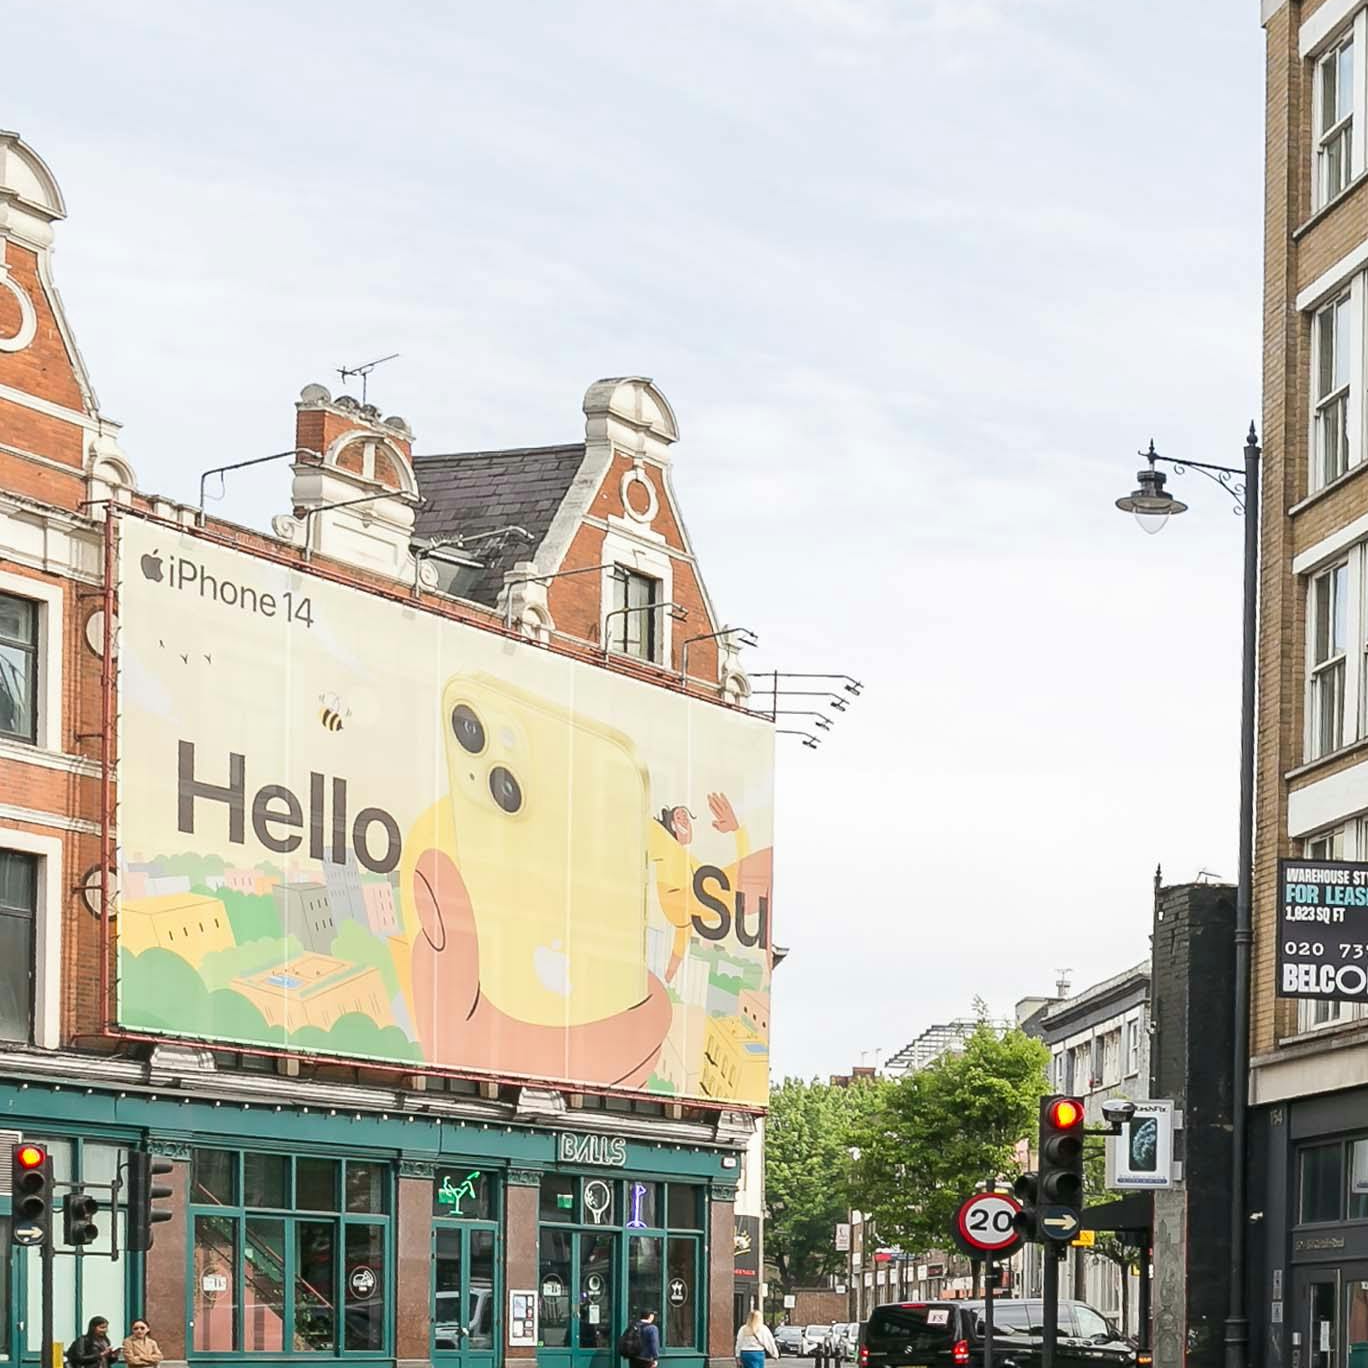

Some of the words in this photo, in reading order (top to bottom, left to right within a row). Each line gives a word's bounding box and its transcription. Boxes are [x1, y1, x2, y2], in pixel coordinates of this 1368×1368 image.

[169, 555, 277, 617] iPhone
[282, 591, 315, 628] 14
[177, 739, 402, 874] Hello
[1286, 868, 1350, 884] WAREHOUSE
[1285, 884, 1319, 904] FOR
[691, 865, 768, 950] Su
[1316, 907, 1330, 924] SQ
[1333, 907, 1346, 922] FT
[1285, 942, 1324, 956] 020
[561, 1132, 626, 1166] BALLS
[970, 1208, 1014, 1233] 20
